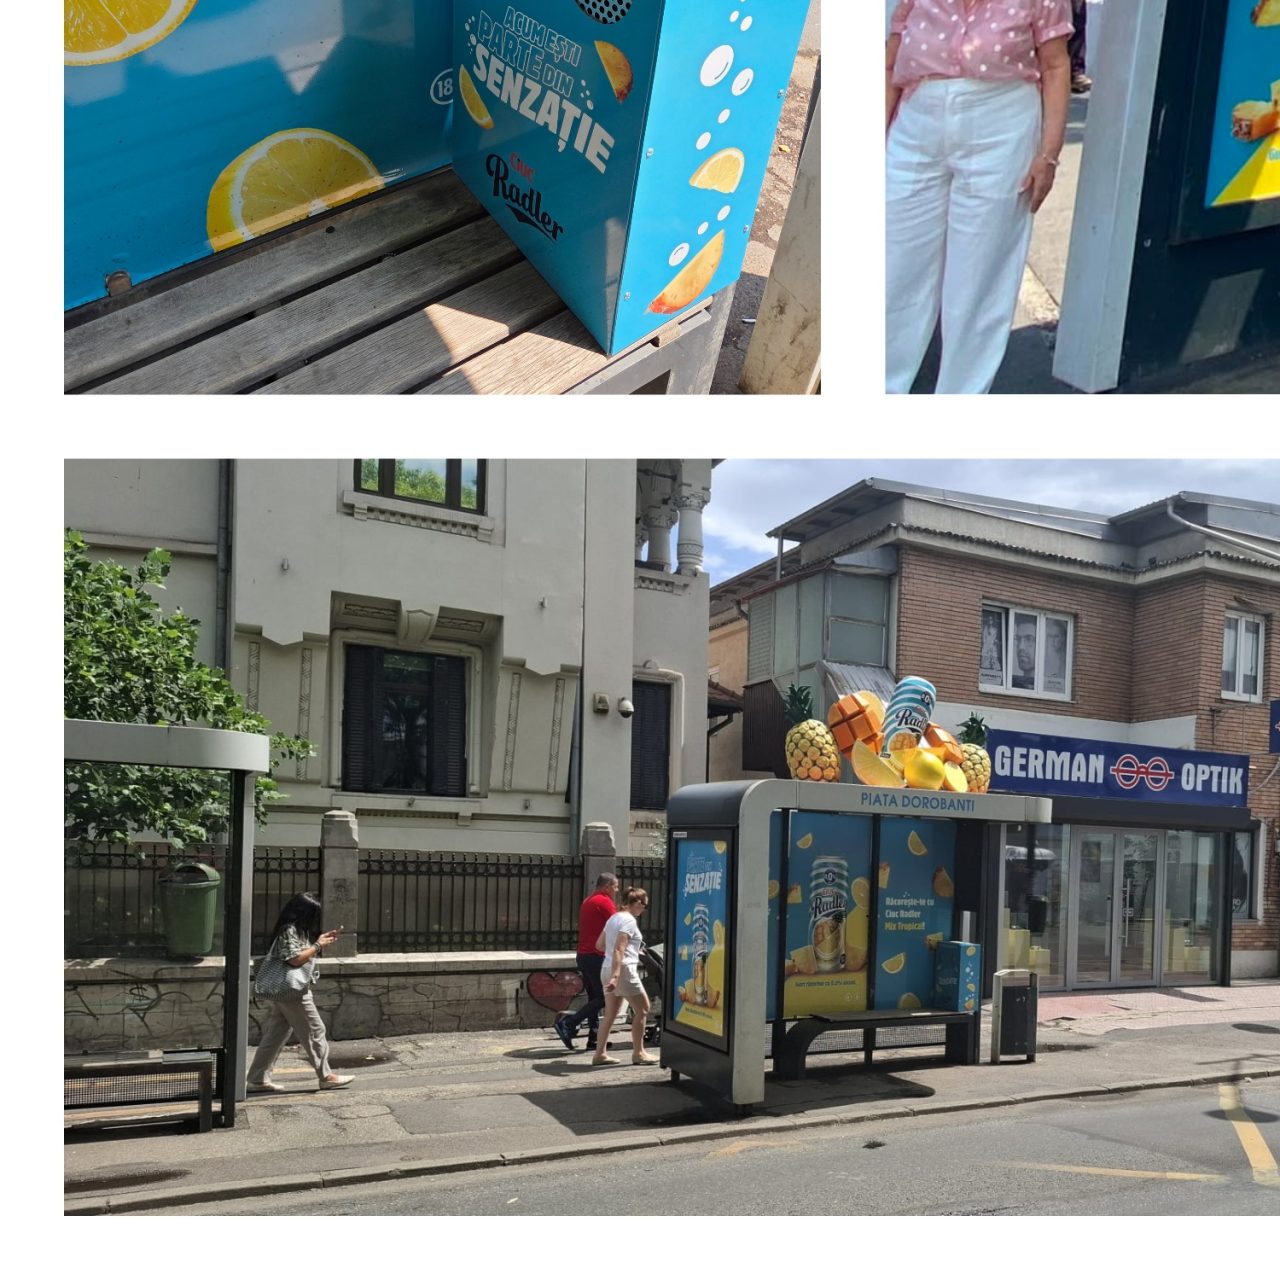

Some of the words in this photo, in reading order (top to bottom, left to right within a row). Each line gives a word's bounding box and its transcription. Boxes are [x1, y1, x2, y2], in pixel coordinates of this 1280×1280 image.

[477, 10, 544, 80] PARTE
[542, 64, 574, 97] DIN
[503, 6, 546, 46] ACUM
[544, 28, 582, 67] EȘTI
[473, 43, 615, 174] SENZAȚIE
[486, 153, 564, 241] Radler
[861, 792, 897, 807] PIATA
[902, 795, 975, 812] DOROBANTI
[994, 745, 1104, 783] GERMAN
[1181, 762, 1243, 795] OPTIK
